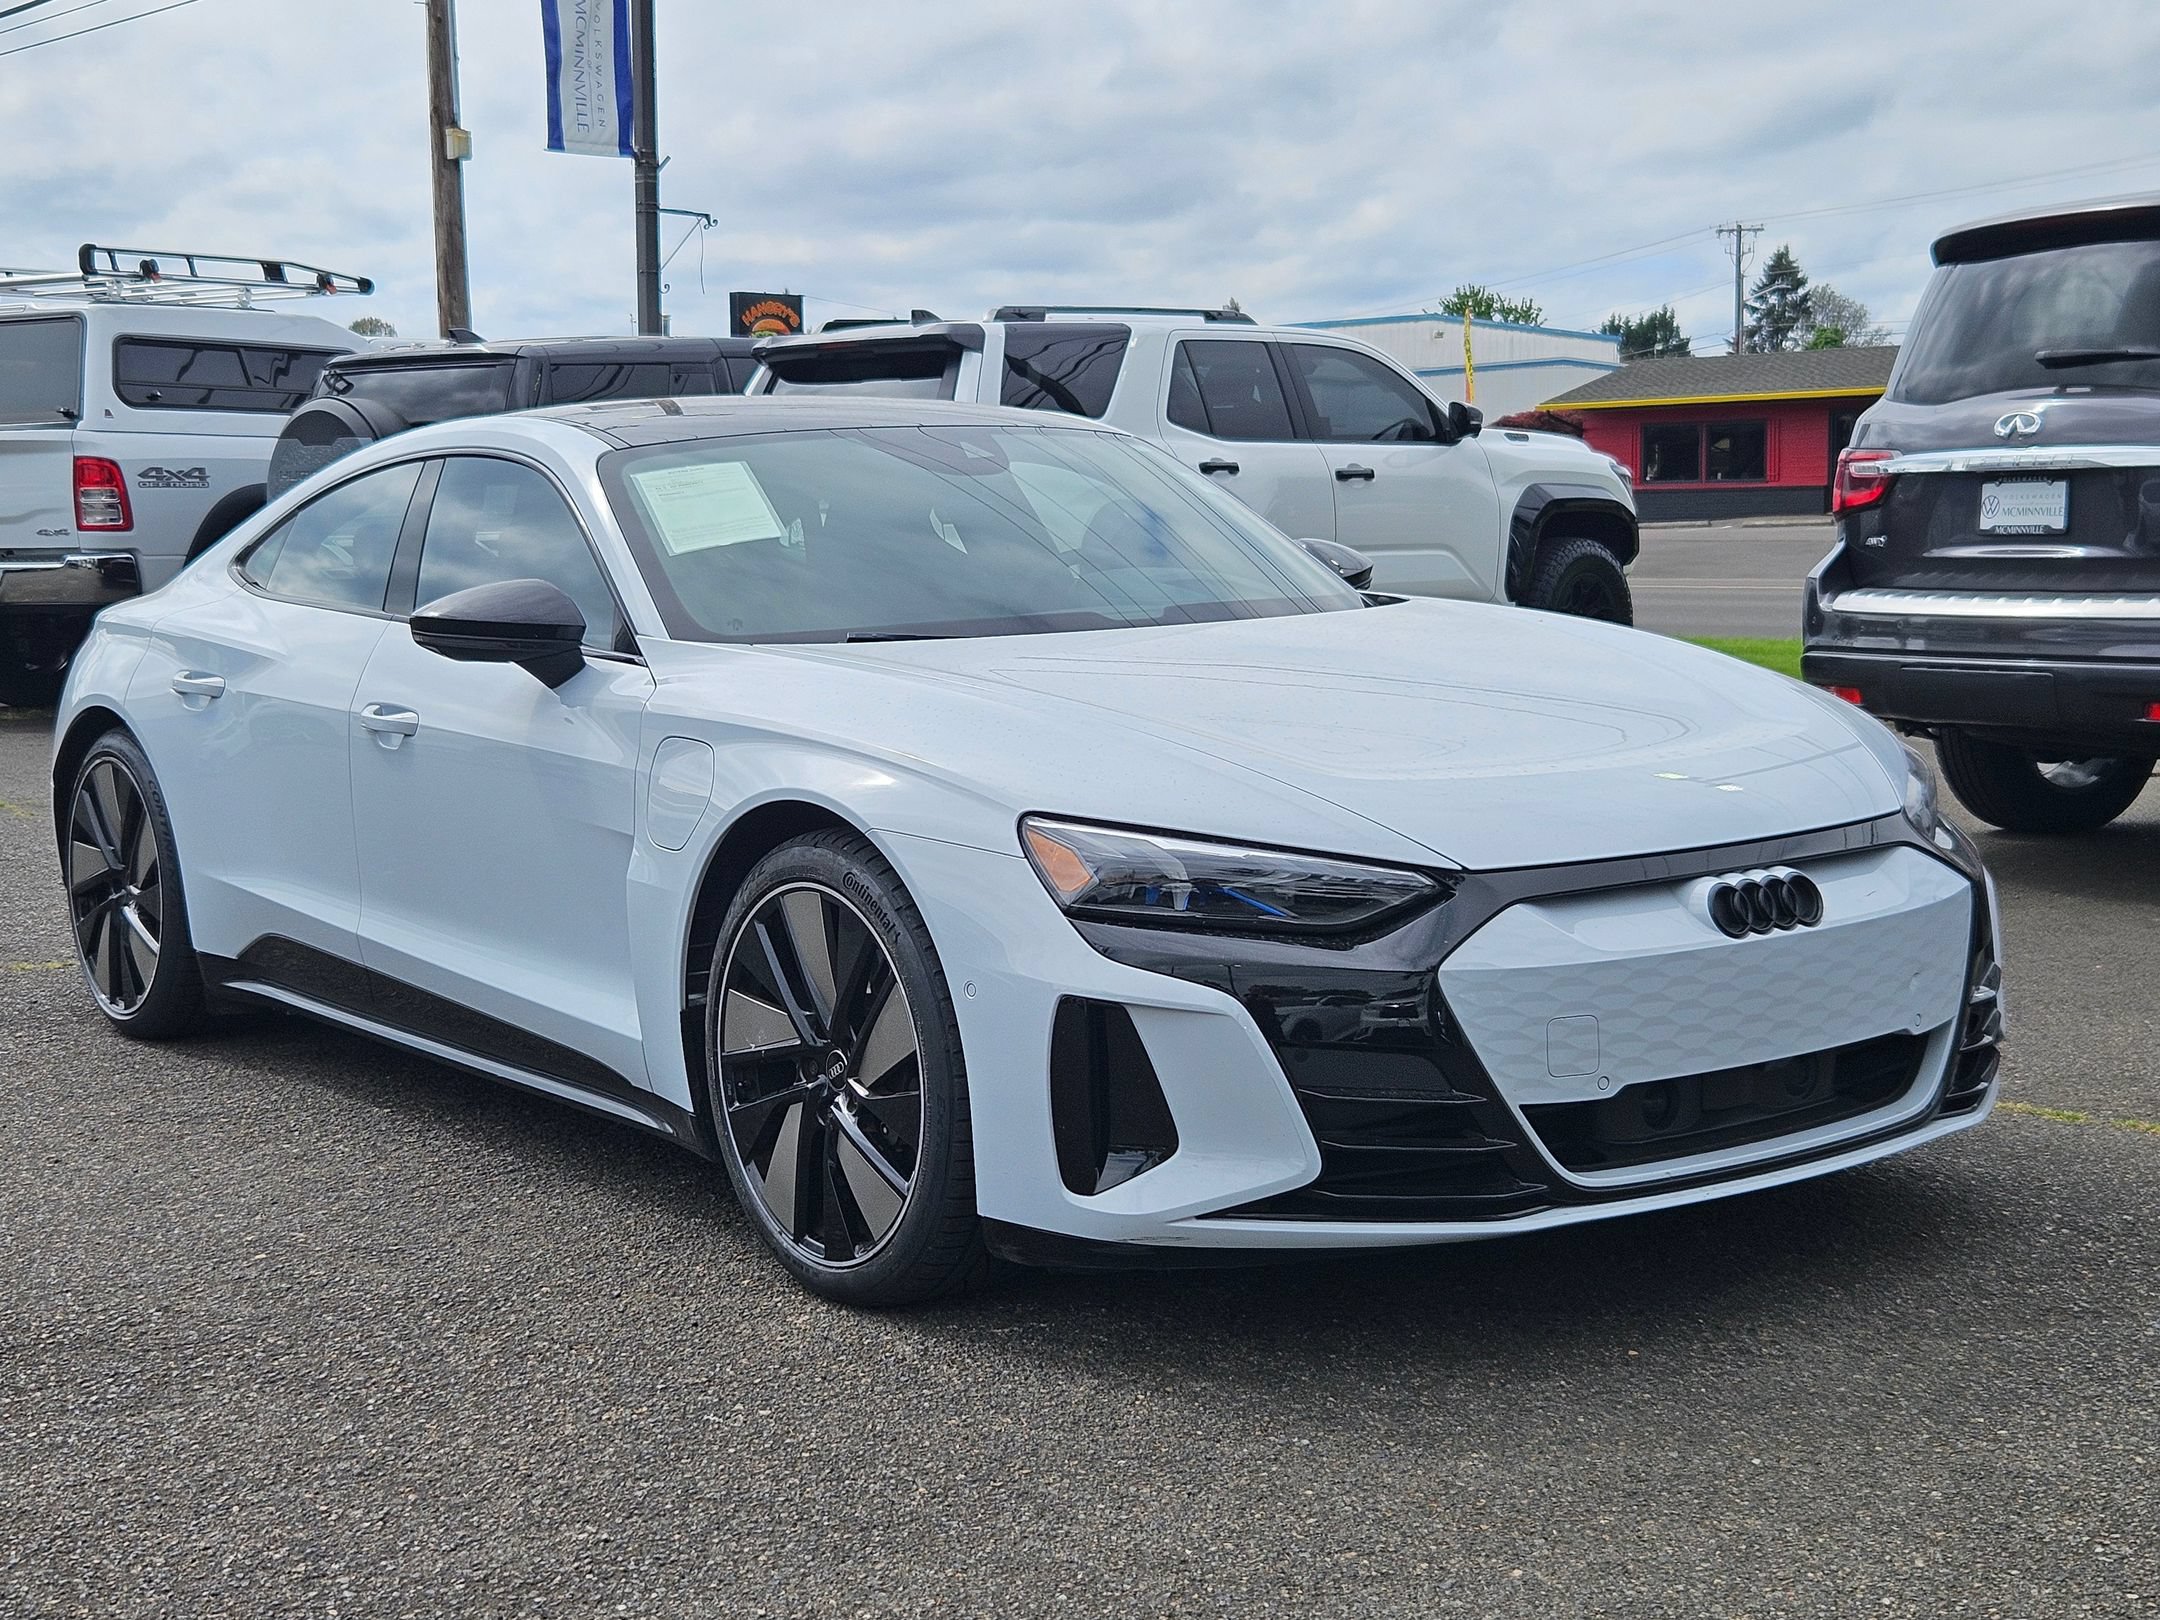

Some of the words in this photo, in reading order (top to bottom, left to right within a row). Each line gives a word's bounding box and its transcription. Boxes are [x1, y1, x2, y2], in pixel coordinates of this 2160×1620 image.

[574, 0, 589, 133] MCMINNVILLE
[594, 2, 606, 128] VOLKSWAGEN
[1995, 526, 2044, 534] MCMINNVILLE
[2003, 507, 2064, 517] MCMINNVILLE
[843, 872, 896, 932] Continental
